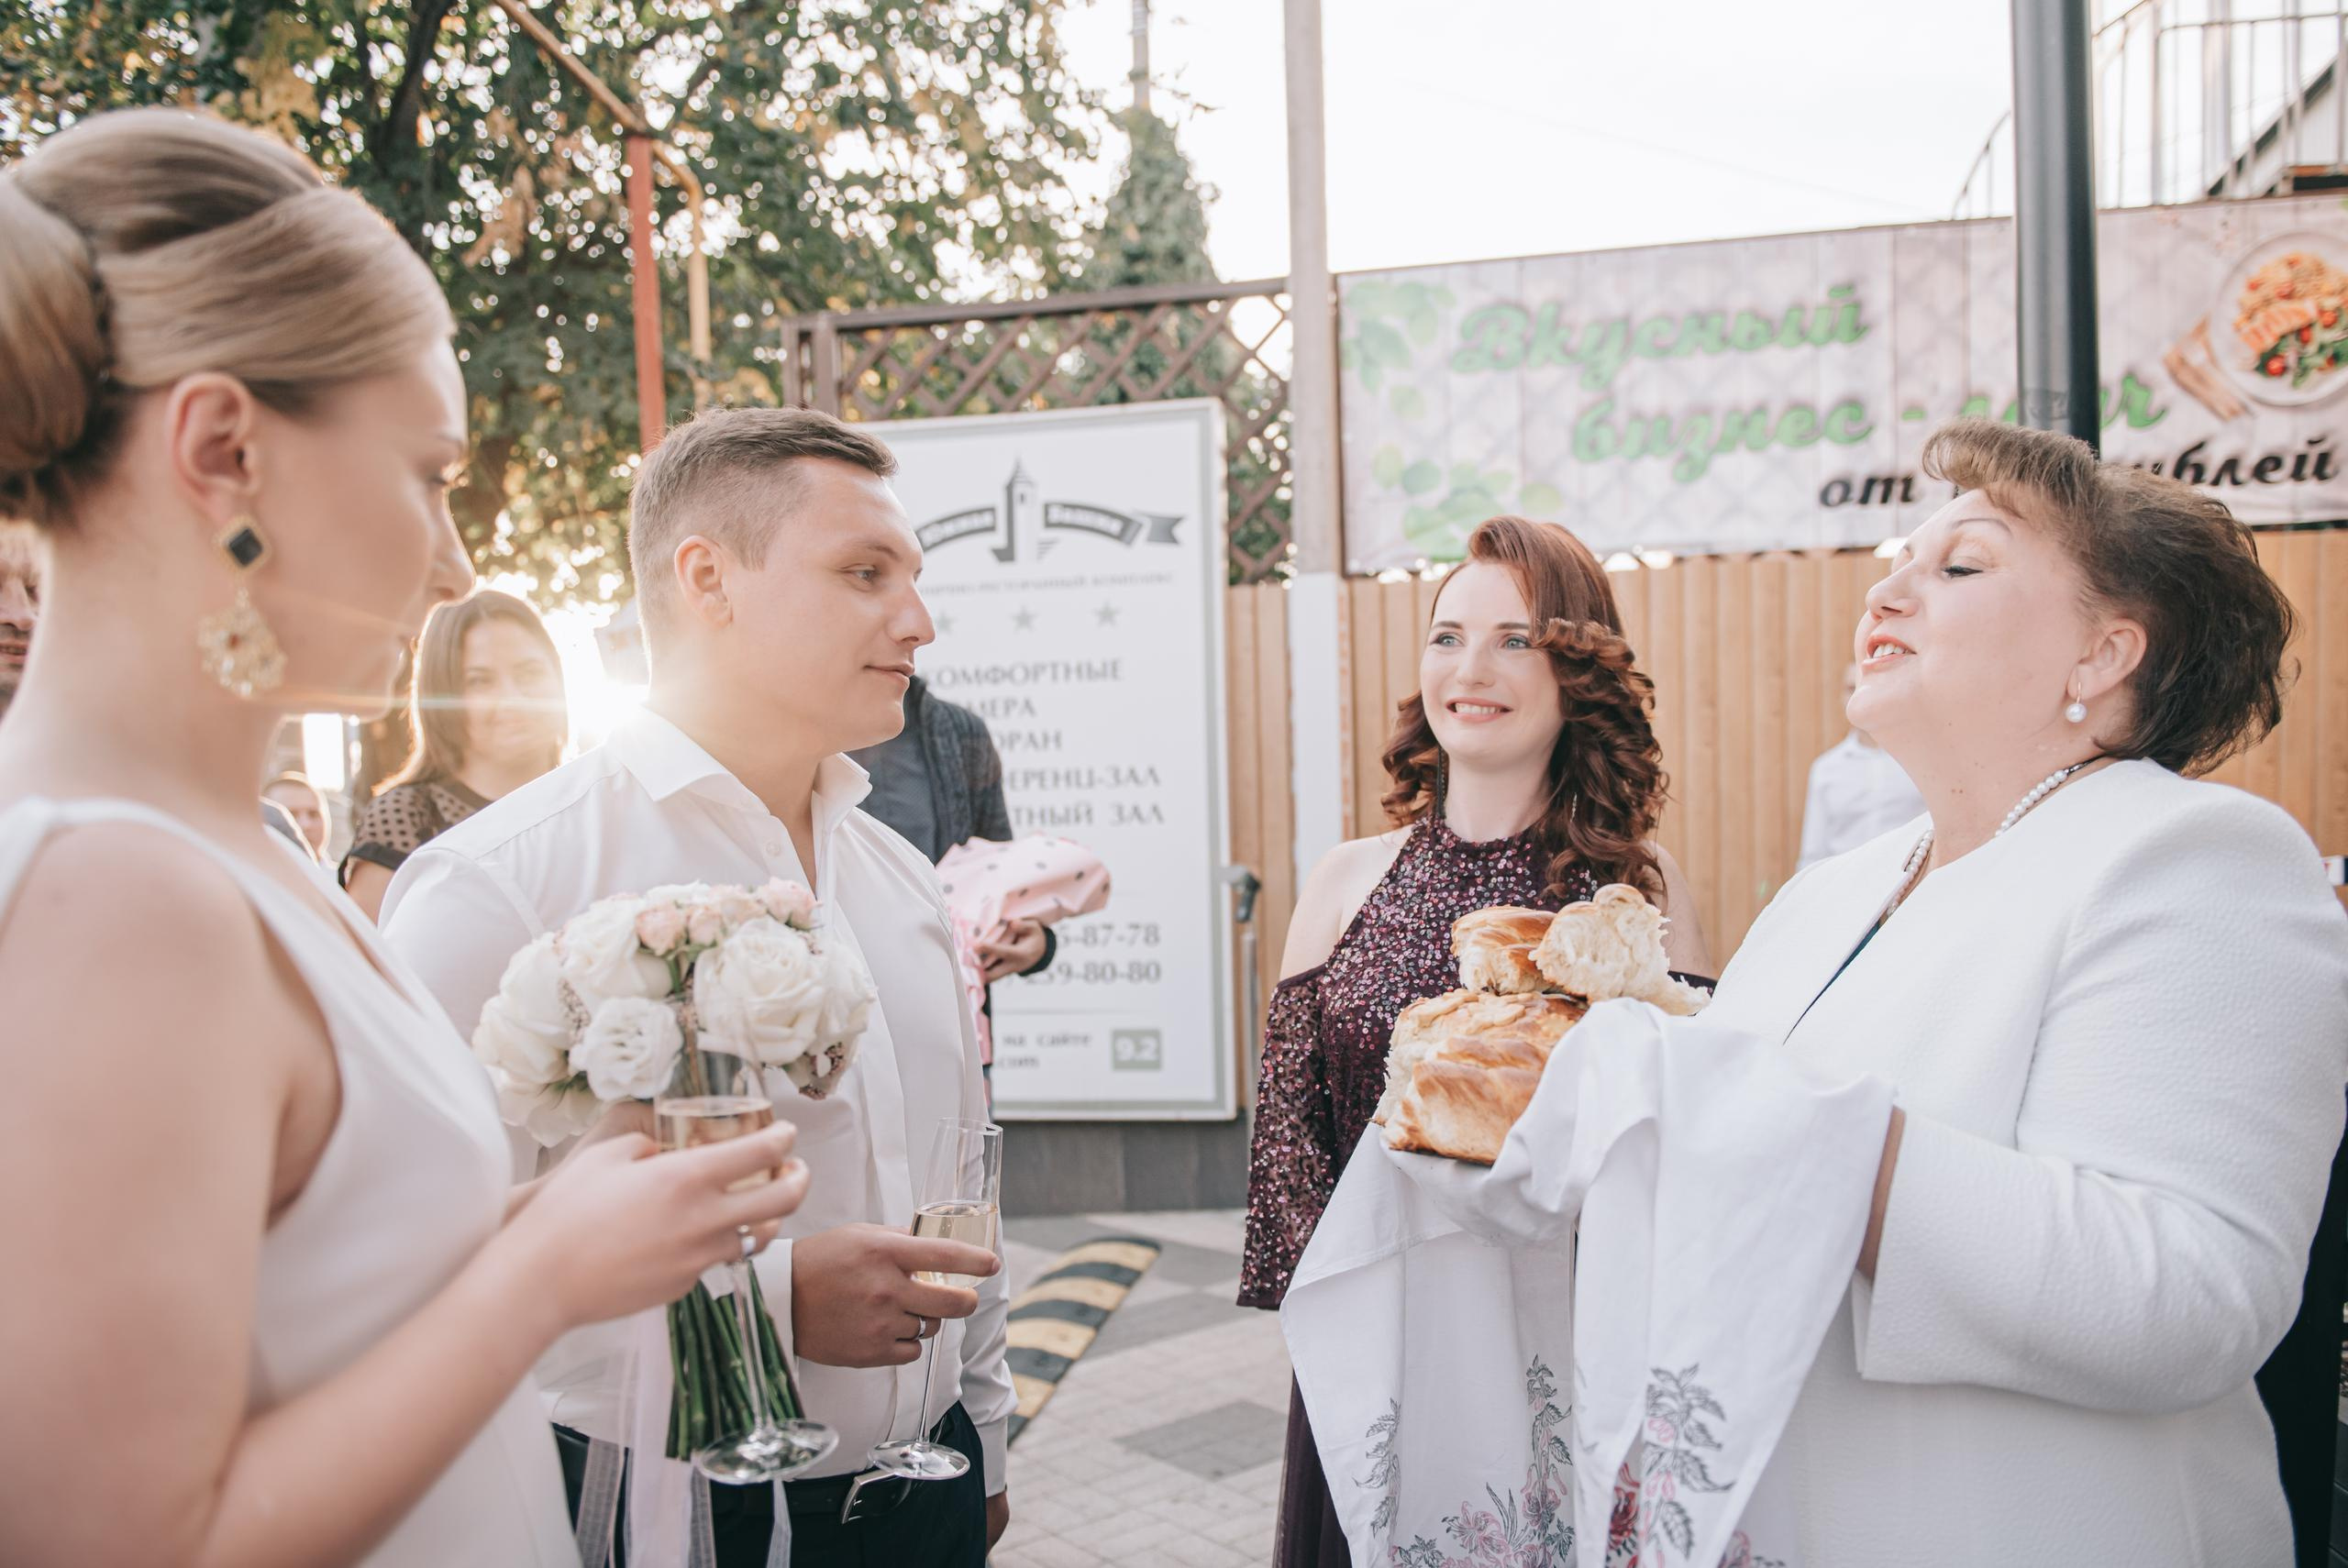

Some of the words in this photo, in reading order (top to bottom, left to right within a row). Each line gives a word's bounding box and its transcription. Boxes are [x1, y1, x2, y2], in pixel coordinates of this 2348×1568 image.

[1449, 283, 1870, 391] Вкусный
[1571, 396, 1875, 483] бизнес
[1821, 473, 1915, 507] от
[1008, 766, 1161, 791] ЕРЕНЦ-ЗАЛ
[1108, 802, 1165, 824] ЗАЛ
